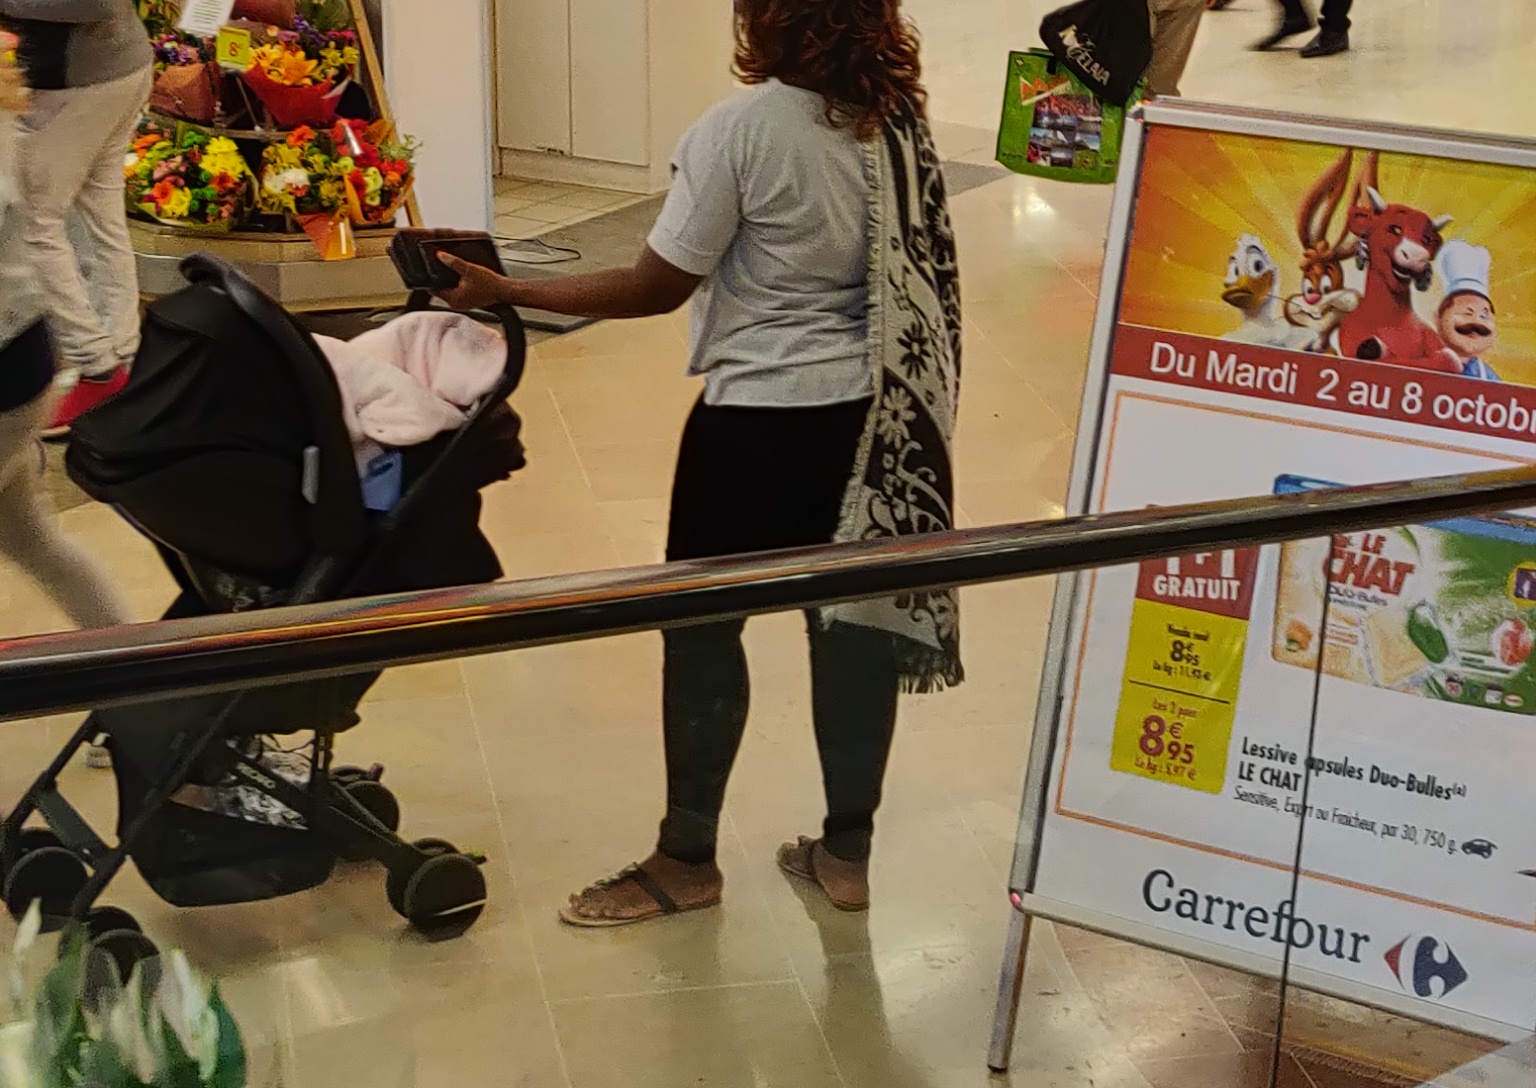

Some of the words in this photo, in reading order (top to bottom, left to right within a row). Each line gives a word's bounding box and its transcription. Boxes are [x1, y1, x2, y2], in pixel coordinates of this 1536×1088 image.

[1150, 341, 1194, 379] Du
[1205, 349, 1299, 395] Mardi
[1316, 368, 1341, 401] 2
[1348, 380, 1391, 410] au
[1401, 381, 1423, 414] 8
[1362, 533, 1387, 555] LE
[1152, 574, 1241, 601] GRATUIT
[1322, 548, 1416, 598] CHAT
[1242, 736, 1298, 766] Lessive
[1238, 760, 1255, 782] LE
[1260, 766, 1302, 792] CHAT
[1284, 796, 1314, 818] Exprt
[1315, 807, 1329, 820] ou
[1381, 823, 1399, 839] par
[1423, 828, 1447, 850] 750
[1142, 868, 1371, 963] Carrefour
